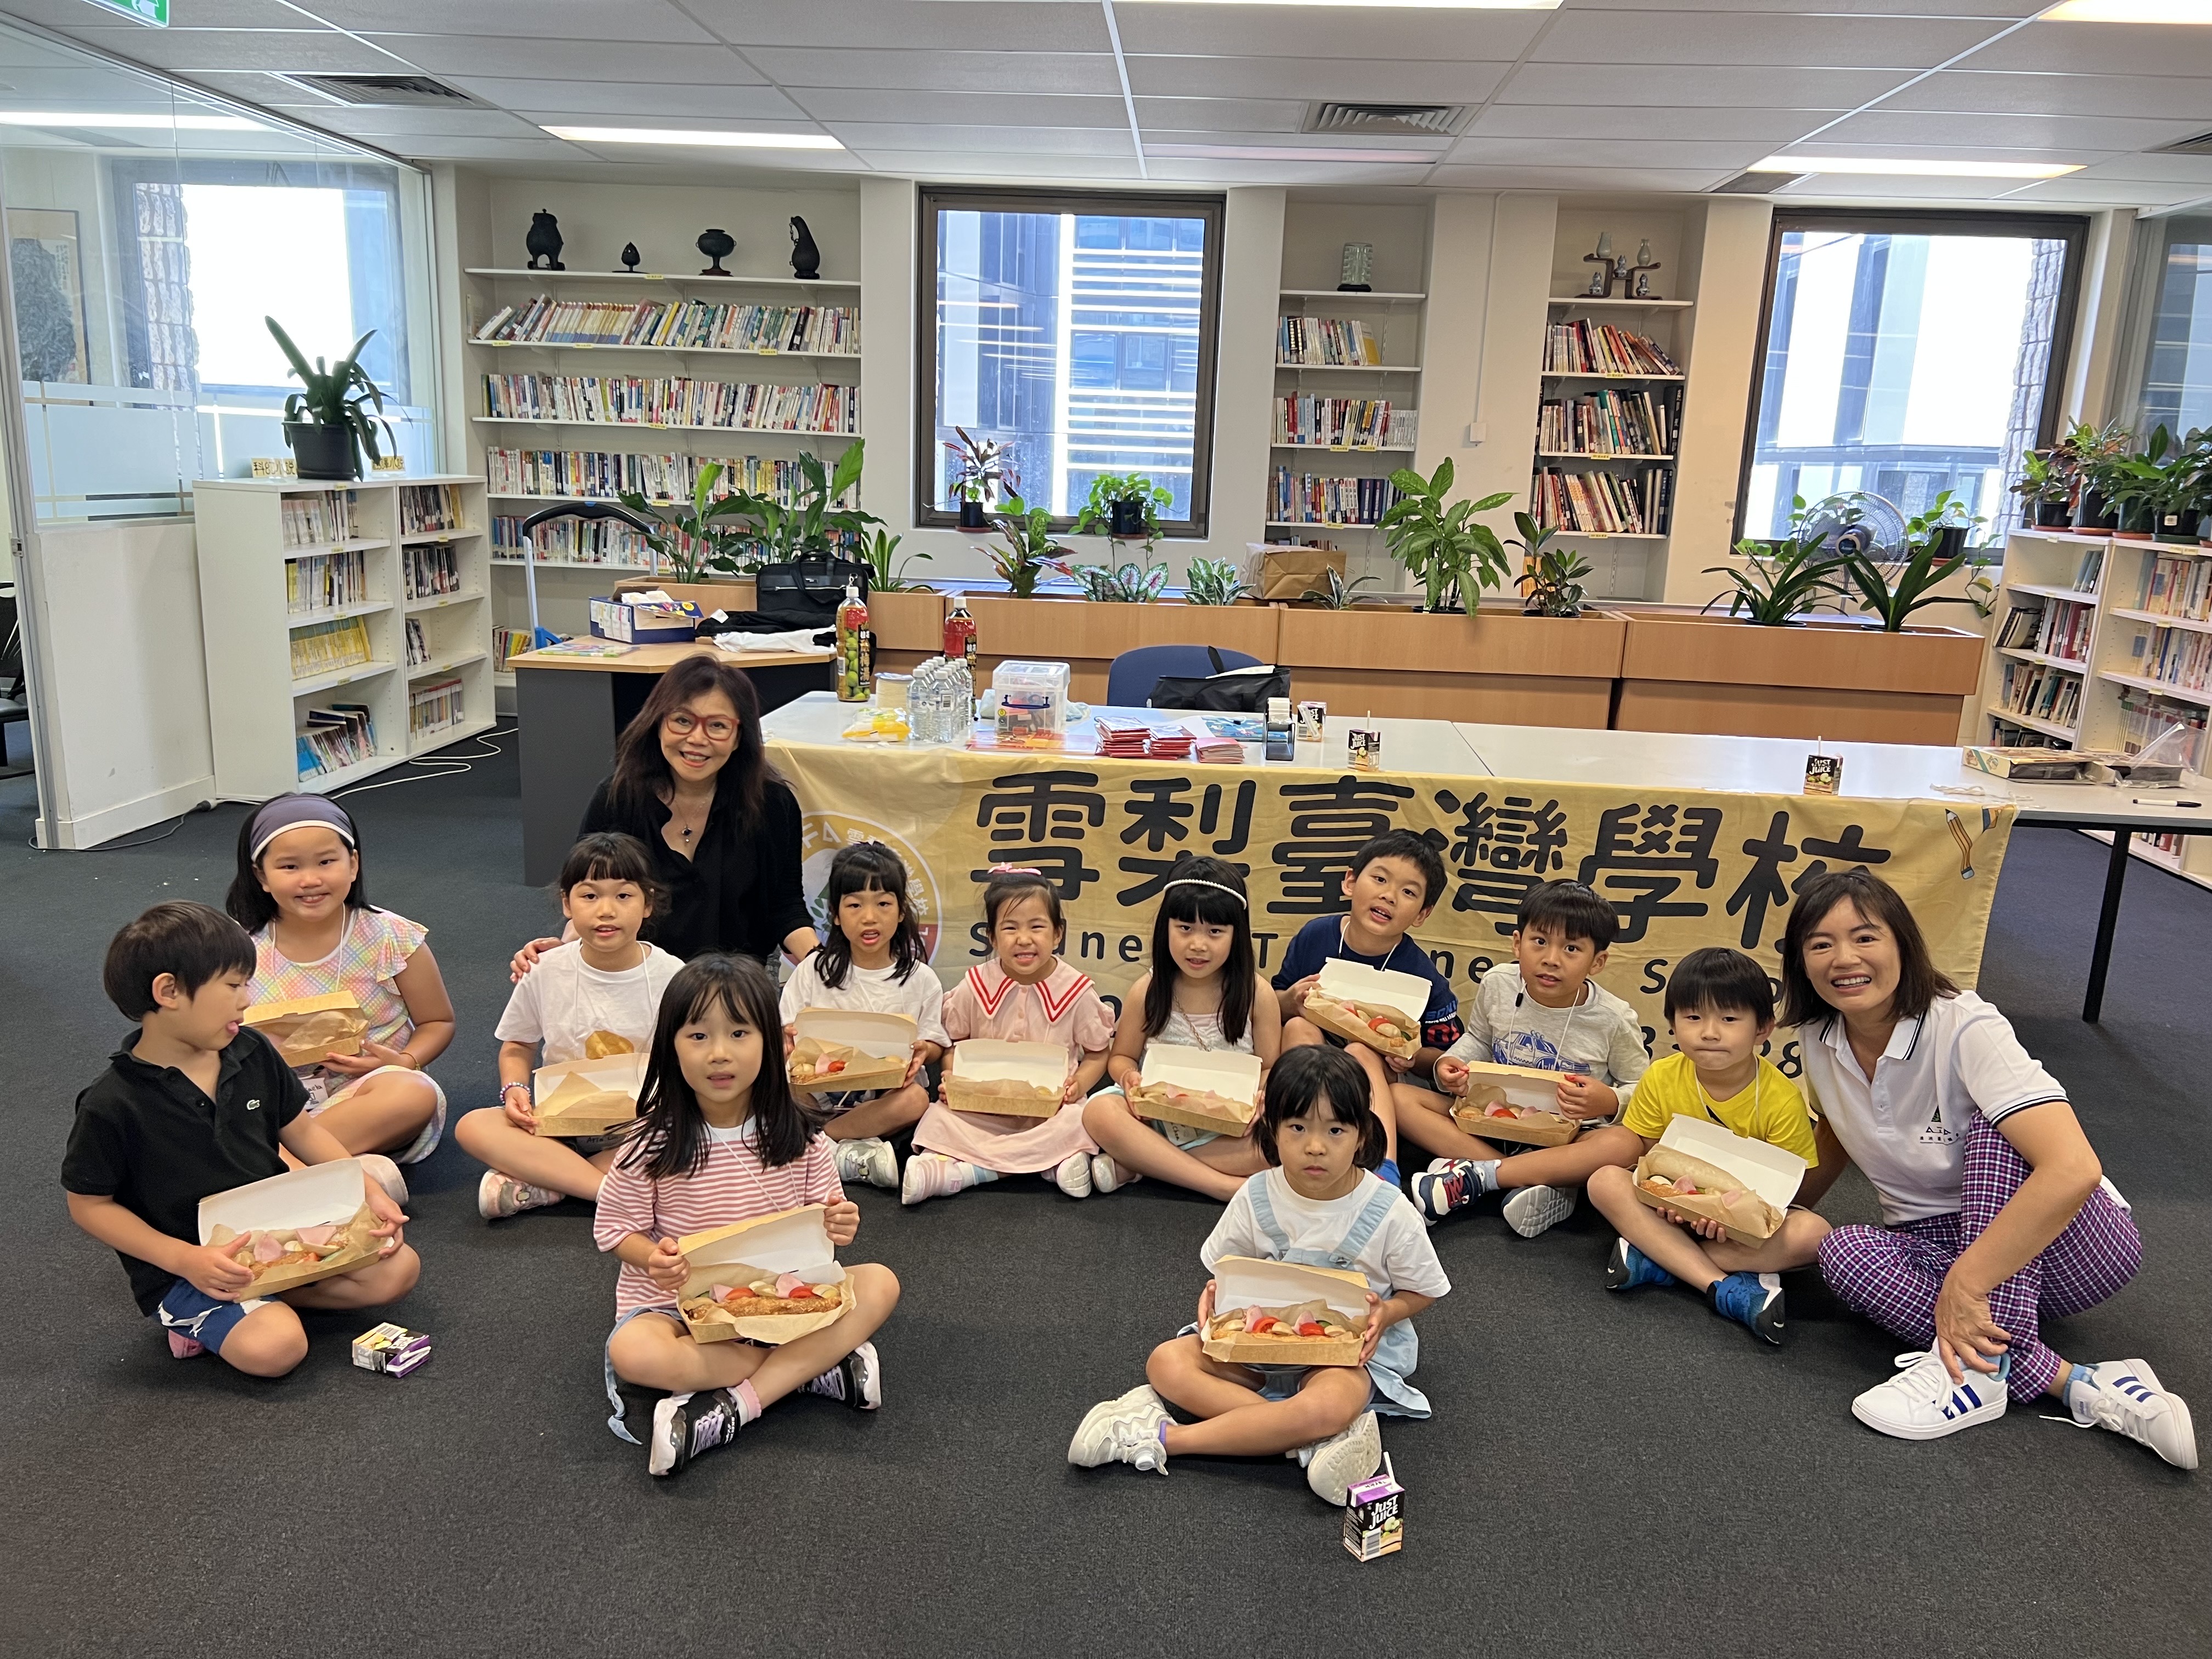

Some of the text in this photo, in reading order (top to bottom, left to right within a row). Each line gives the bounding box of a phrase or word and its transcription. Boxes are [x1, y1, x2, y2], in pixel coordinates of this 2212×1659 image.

[1352, 732, 1365, 741] JUST
[1350, 740, 1367, 749] JUICE
[1809, 765, 1831, 775] JUICE
[1371, 1494, 1398, 1516] JUST
[1369, 1504, 1398, 1530] JUICE
